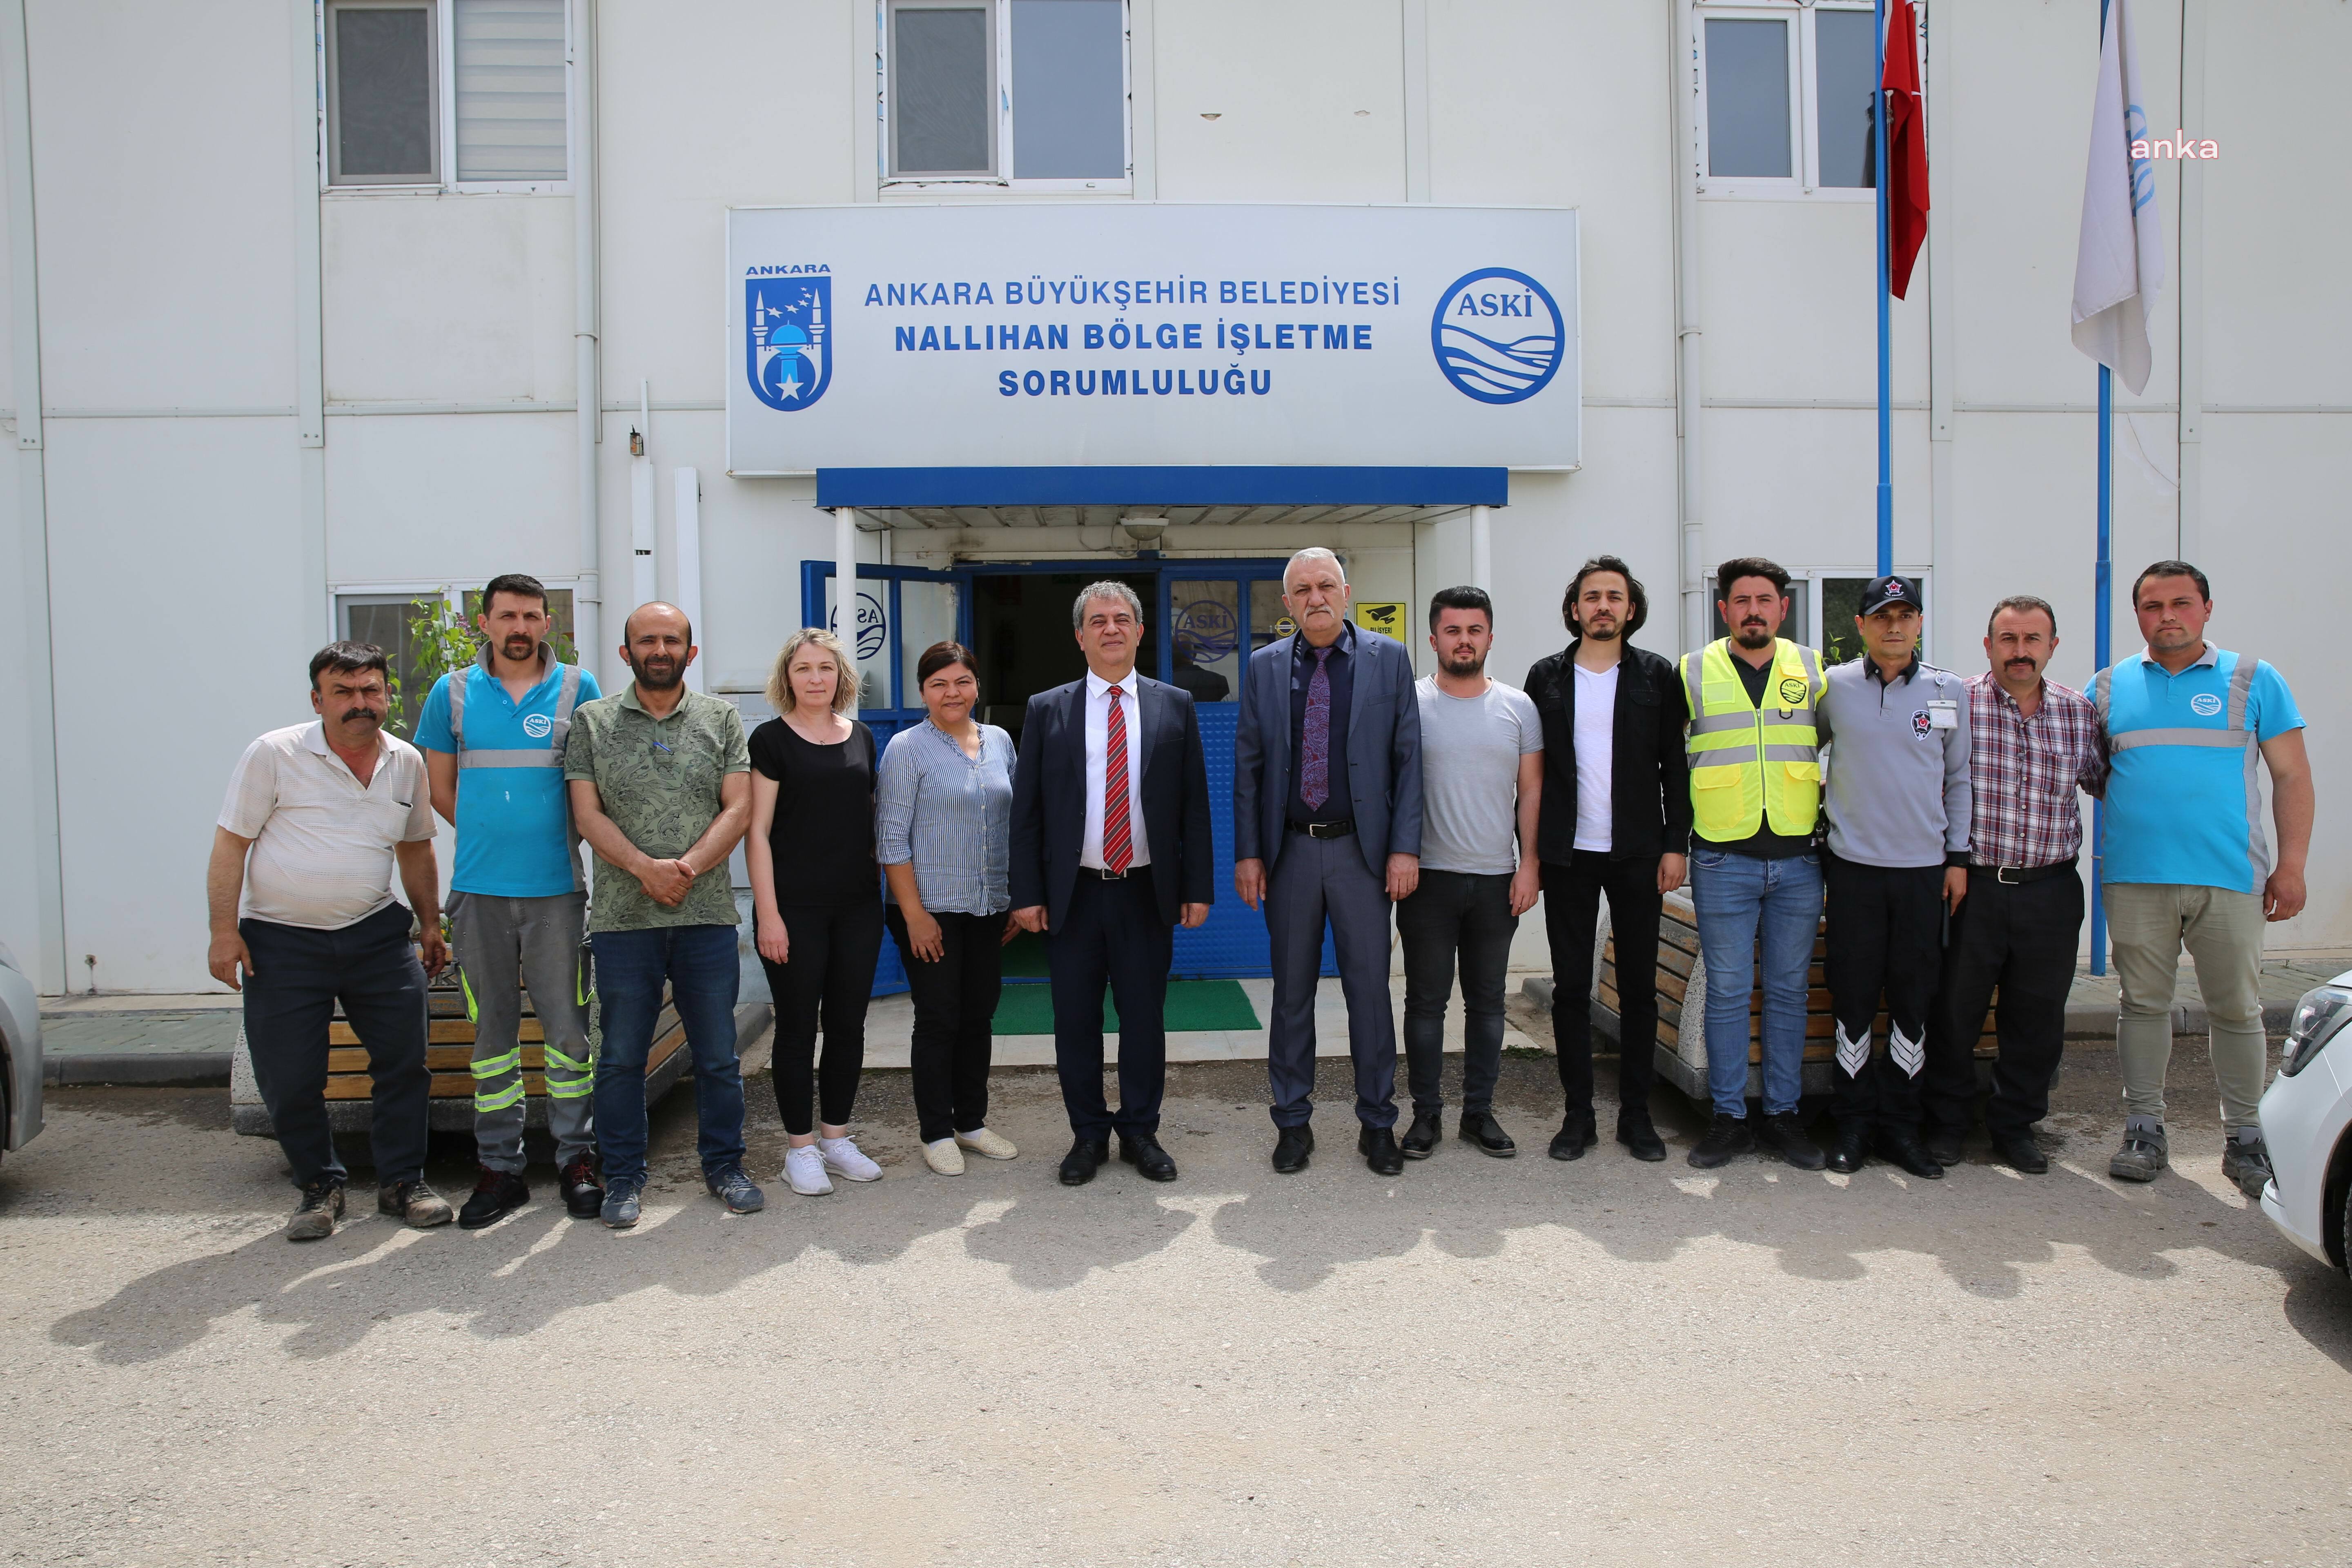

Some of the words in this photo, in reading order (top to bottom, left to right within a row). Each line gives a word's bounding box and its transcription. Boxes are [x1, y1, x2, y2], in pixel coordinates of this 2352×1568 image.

[746, 264, 830, 275] ANKARA
[865, 282, 993, 306] ANKARA
[1006, 274, 1207, 311] BÜYÜKŞEHİR
[1220, 274, 1400, 305] BELEDİYESİ
[1458, 287, 1533, 317] ASKİ
[895, 324, 1068, 351] NALLIHAN
[1084, 317, 1203, 349] BÖLGE
[1217, 317, 1372, 355] İŞLETME
[999, 363, 1271, 396] SORUMLULUĞU
[1183, 611, 1228, 629] ASKİ
